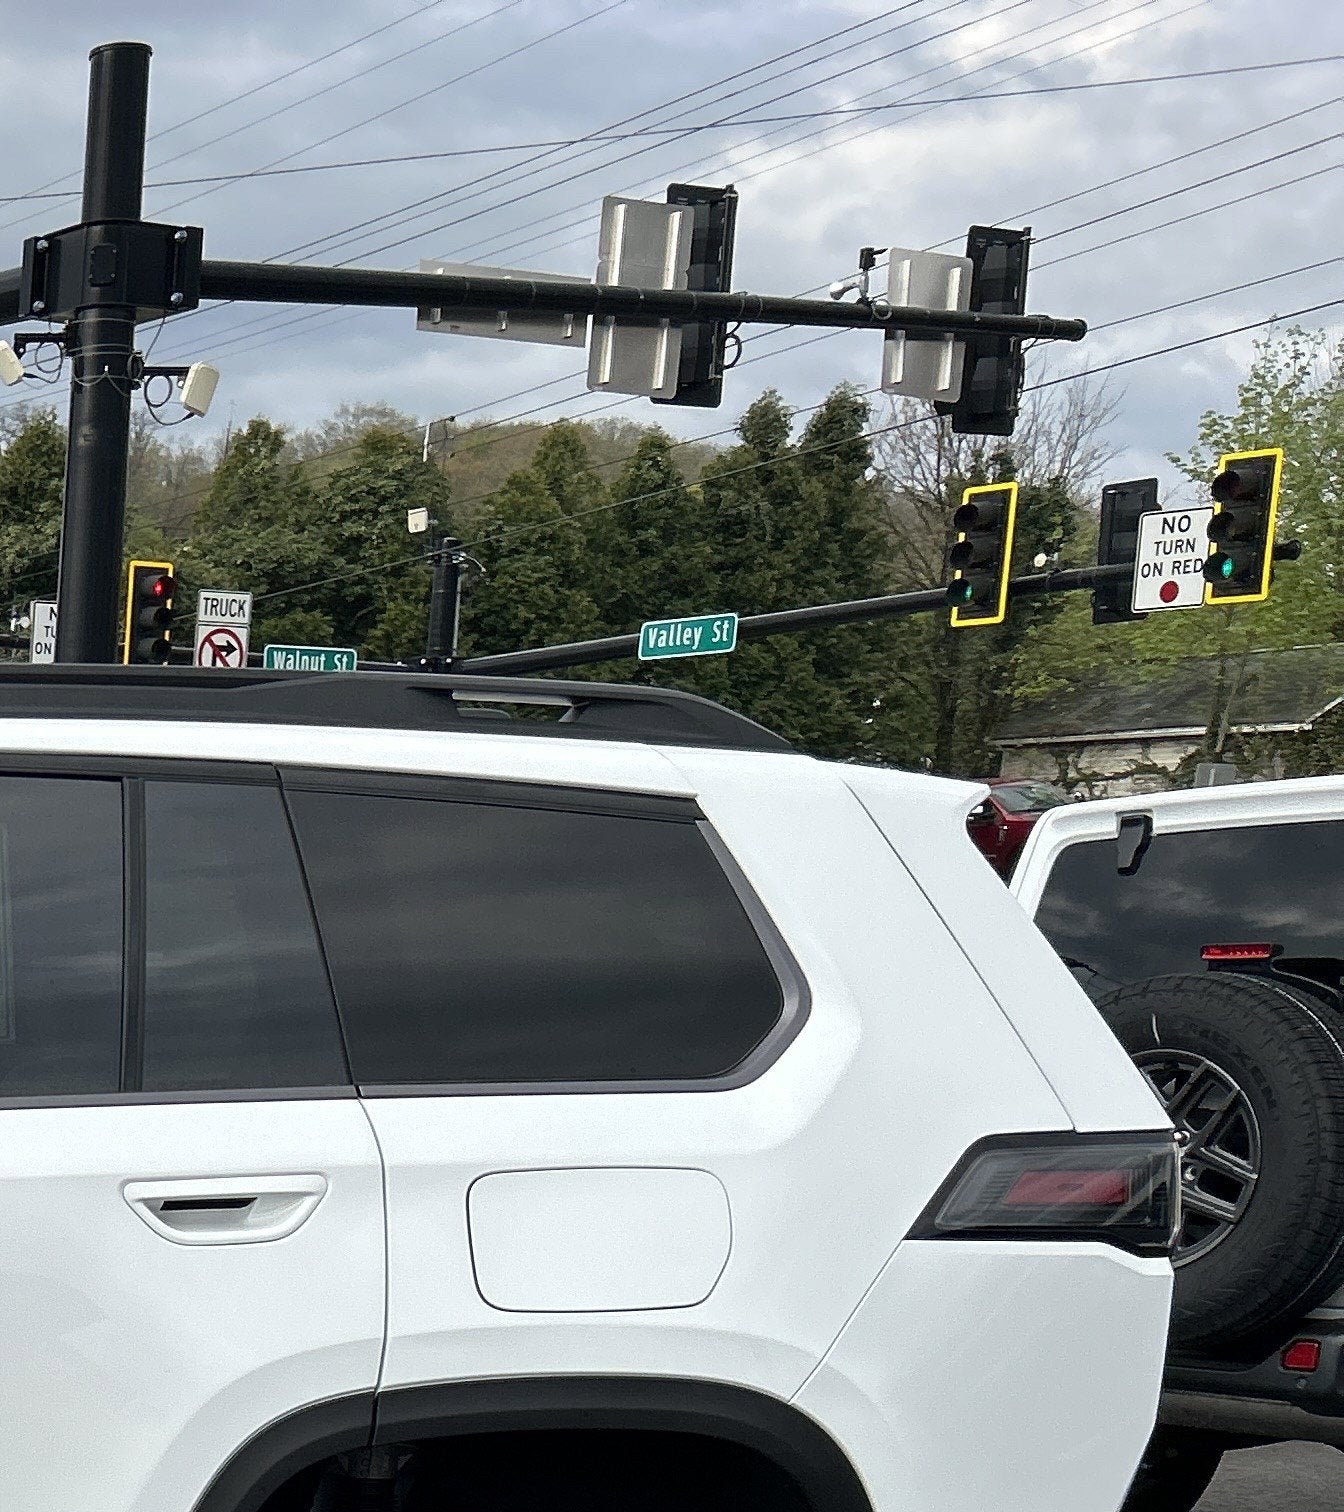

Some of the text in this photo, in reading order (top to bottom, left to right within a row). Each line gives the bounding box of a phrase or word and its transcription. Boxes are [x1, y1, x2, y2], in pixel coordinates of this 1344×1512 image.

[1161, 514, 1192, 535] NO
[1153, 537, 1197, 556] TURN
[1141, 557, 1204, 578] ON RED
[49, 606, 58, 621] N
[202, 596, 247, 618] TRUCK
[648, 619, 730, 650] Valley St
[34, 641, 53, 655] ON
[272, 650, 349, 672] Walnut St
